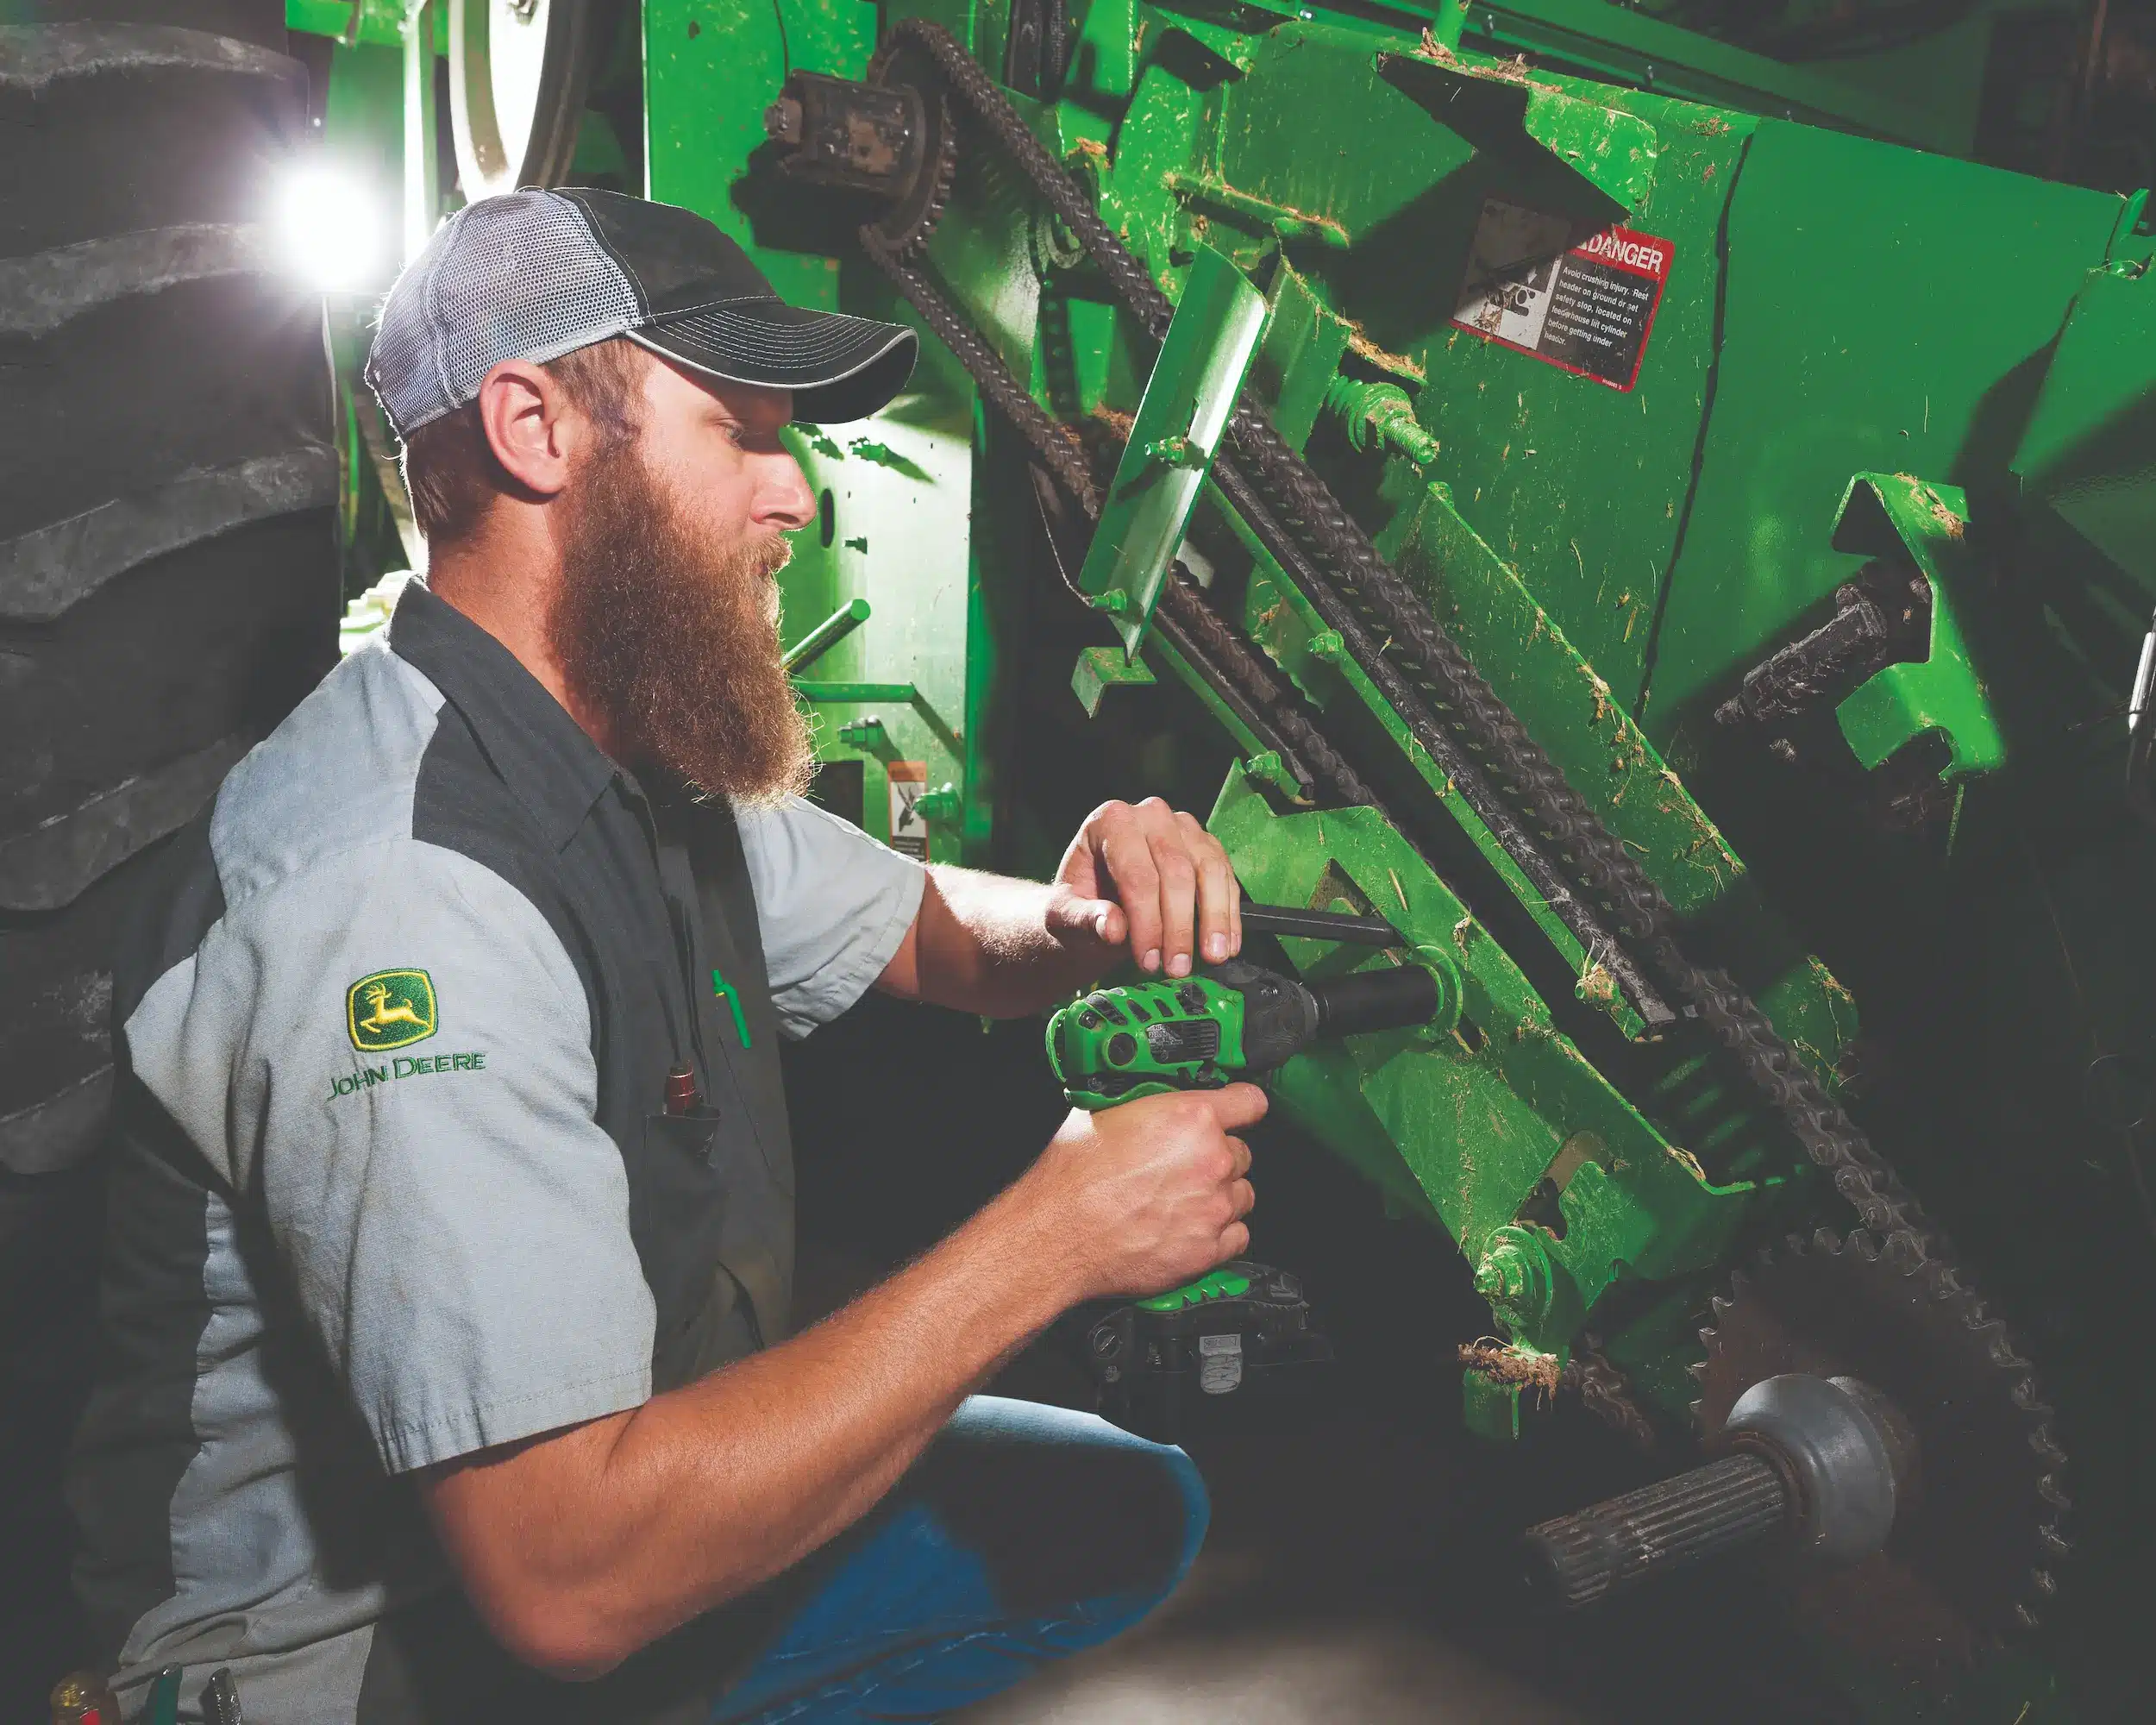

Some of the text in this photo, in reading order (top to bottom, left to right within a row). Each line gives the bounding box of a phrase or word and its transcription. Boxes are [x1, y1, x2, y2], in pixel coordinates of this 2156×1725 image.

[1588, 234, 1664, 273] DANGER
[1559, 279, 1639, 313] header on ground or set
[1563, 267, 1649, 301] Avoid crushing injury. Rest
[1551, 305, 1627, 338] feederhouse lift cylinder
[1555, 293, 1633, 325] safety stop, located on
[1548, 318, 1613, 348] before getting under
[324, 1052, 487, 1101] JOHN DEERE
